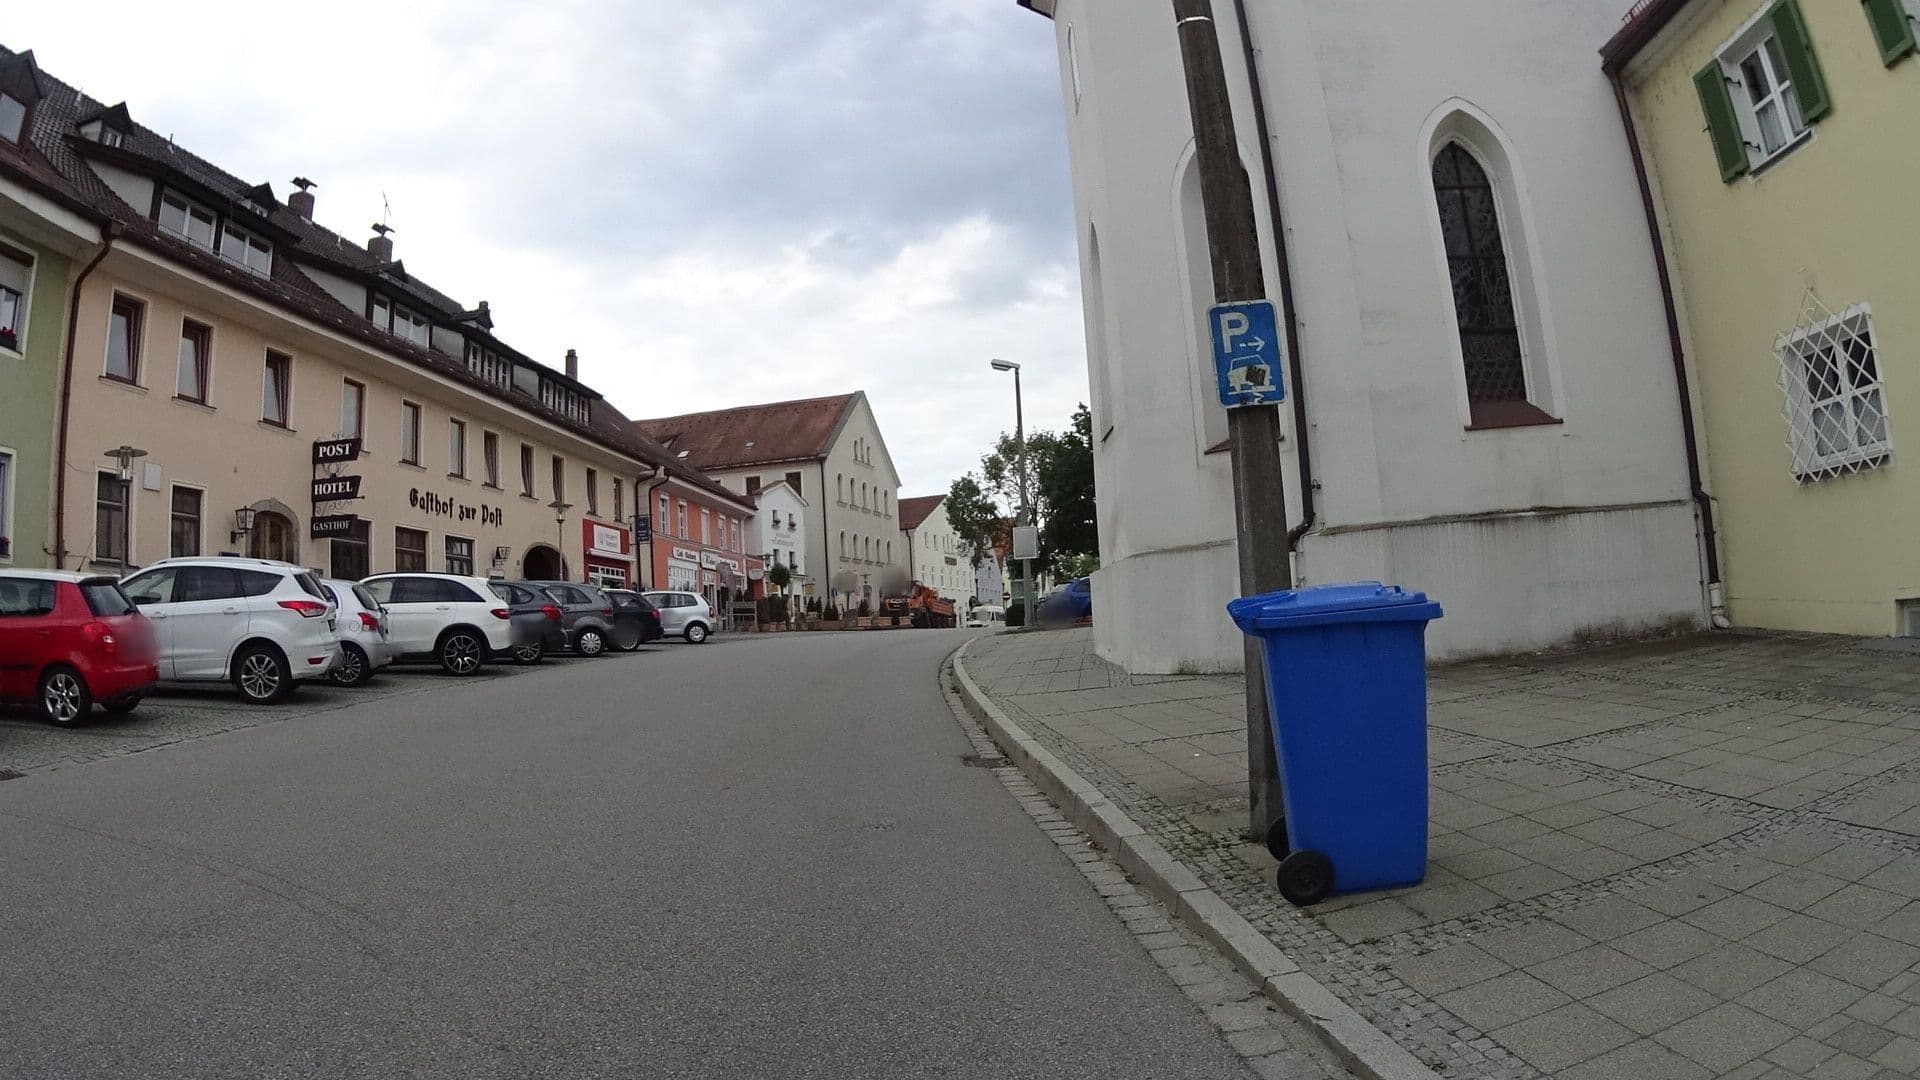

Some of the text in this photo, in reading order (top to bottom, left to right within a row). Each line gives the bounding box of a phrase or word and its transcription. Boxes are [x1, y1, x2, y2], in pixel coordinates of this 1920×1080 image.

[1220, 312, 1249, 353] P
[318, 443, 352, 458] POST
[314, 481, 353, 495] HOTEL
[409, 488, 502, 528] Gasthof zur Post
[312, 520, 351, 531] GASTHOF
